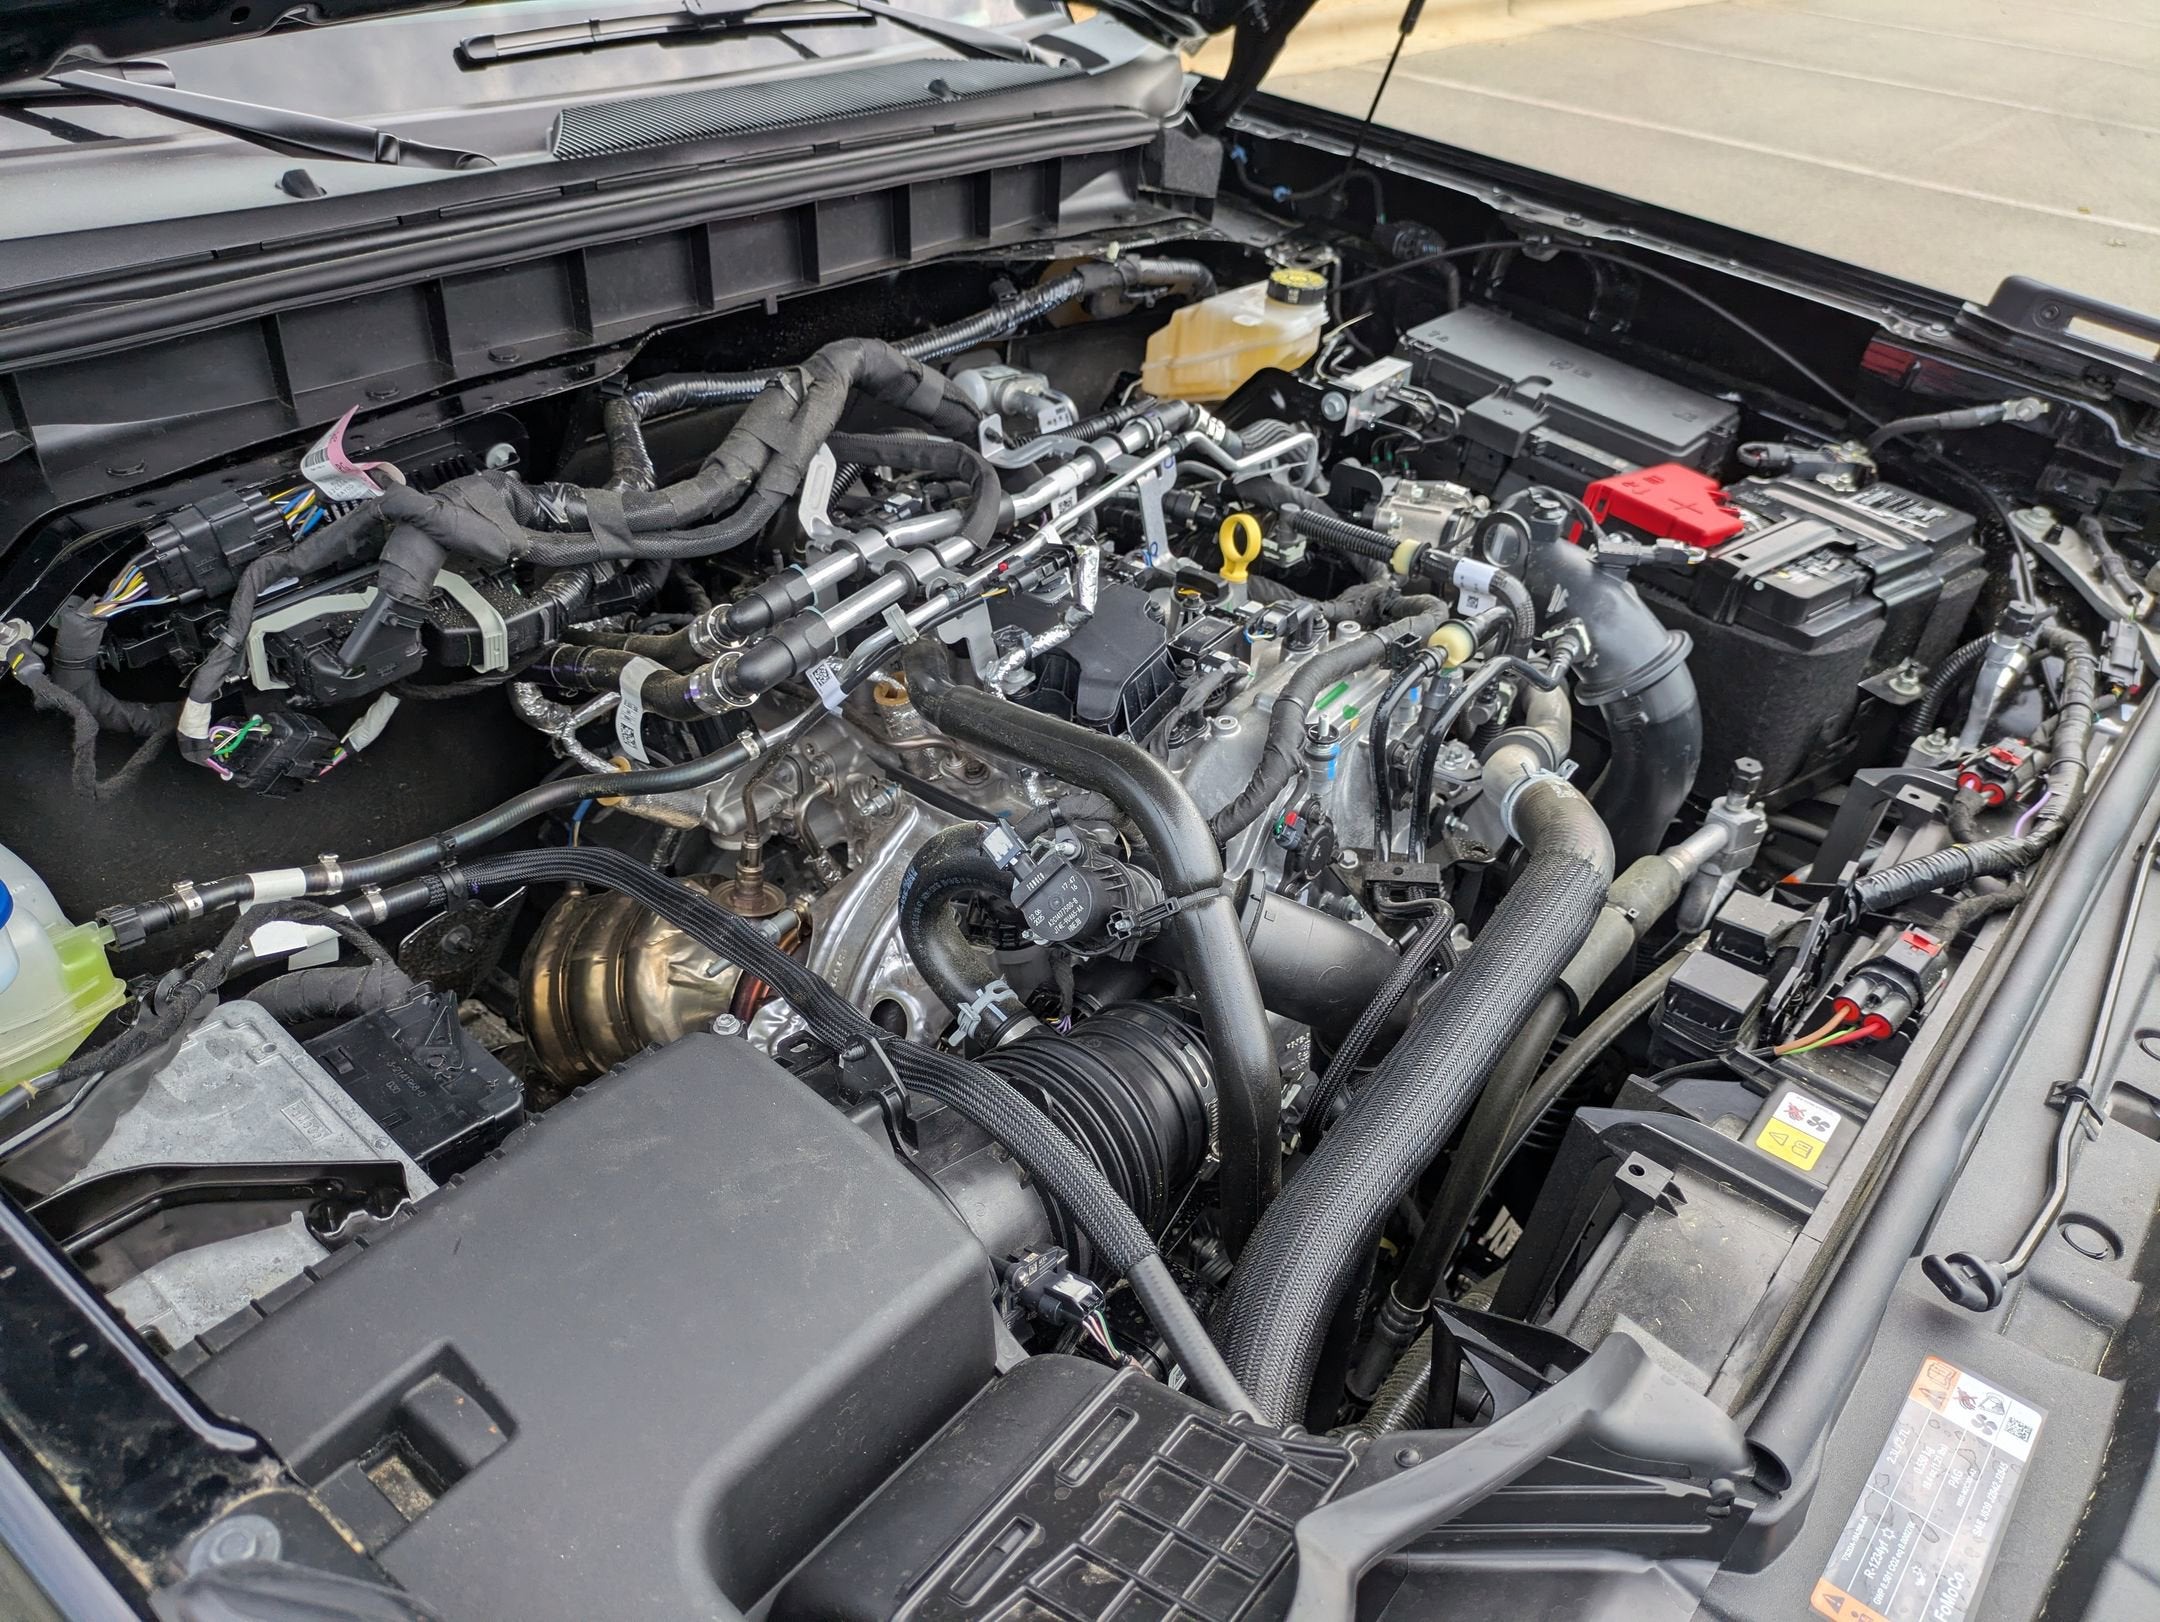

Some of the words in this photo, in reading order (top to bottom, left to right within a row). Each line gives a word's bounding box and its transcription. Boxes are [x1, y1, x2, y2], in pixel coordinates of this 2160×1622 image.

[1886, 1447, 1900, 1464] 2.3L
[1897, 1428, 1910, 1444] 2.7L
[1947, 1469, 1964, 1487] PAG
[1972, 1518, 1986, 1535] SAE
[1864, 1539, 1890, 1579] R-1234yf
[1873, 1588, 1886, 1605] GWP
[1888, 1557, 1899, 1571] CO2
[1935, 1571, 1965, 1622] FoMoCo
